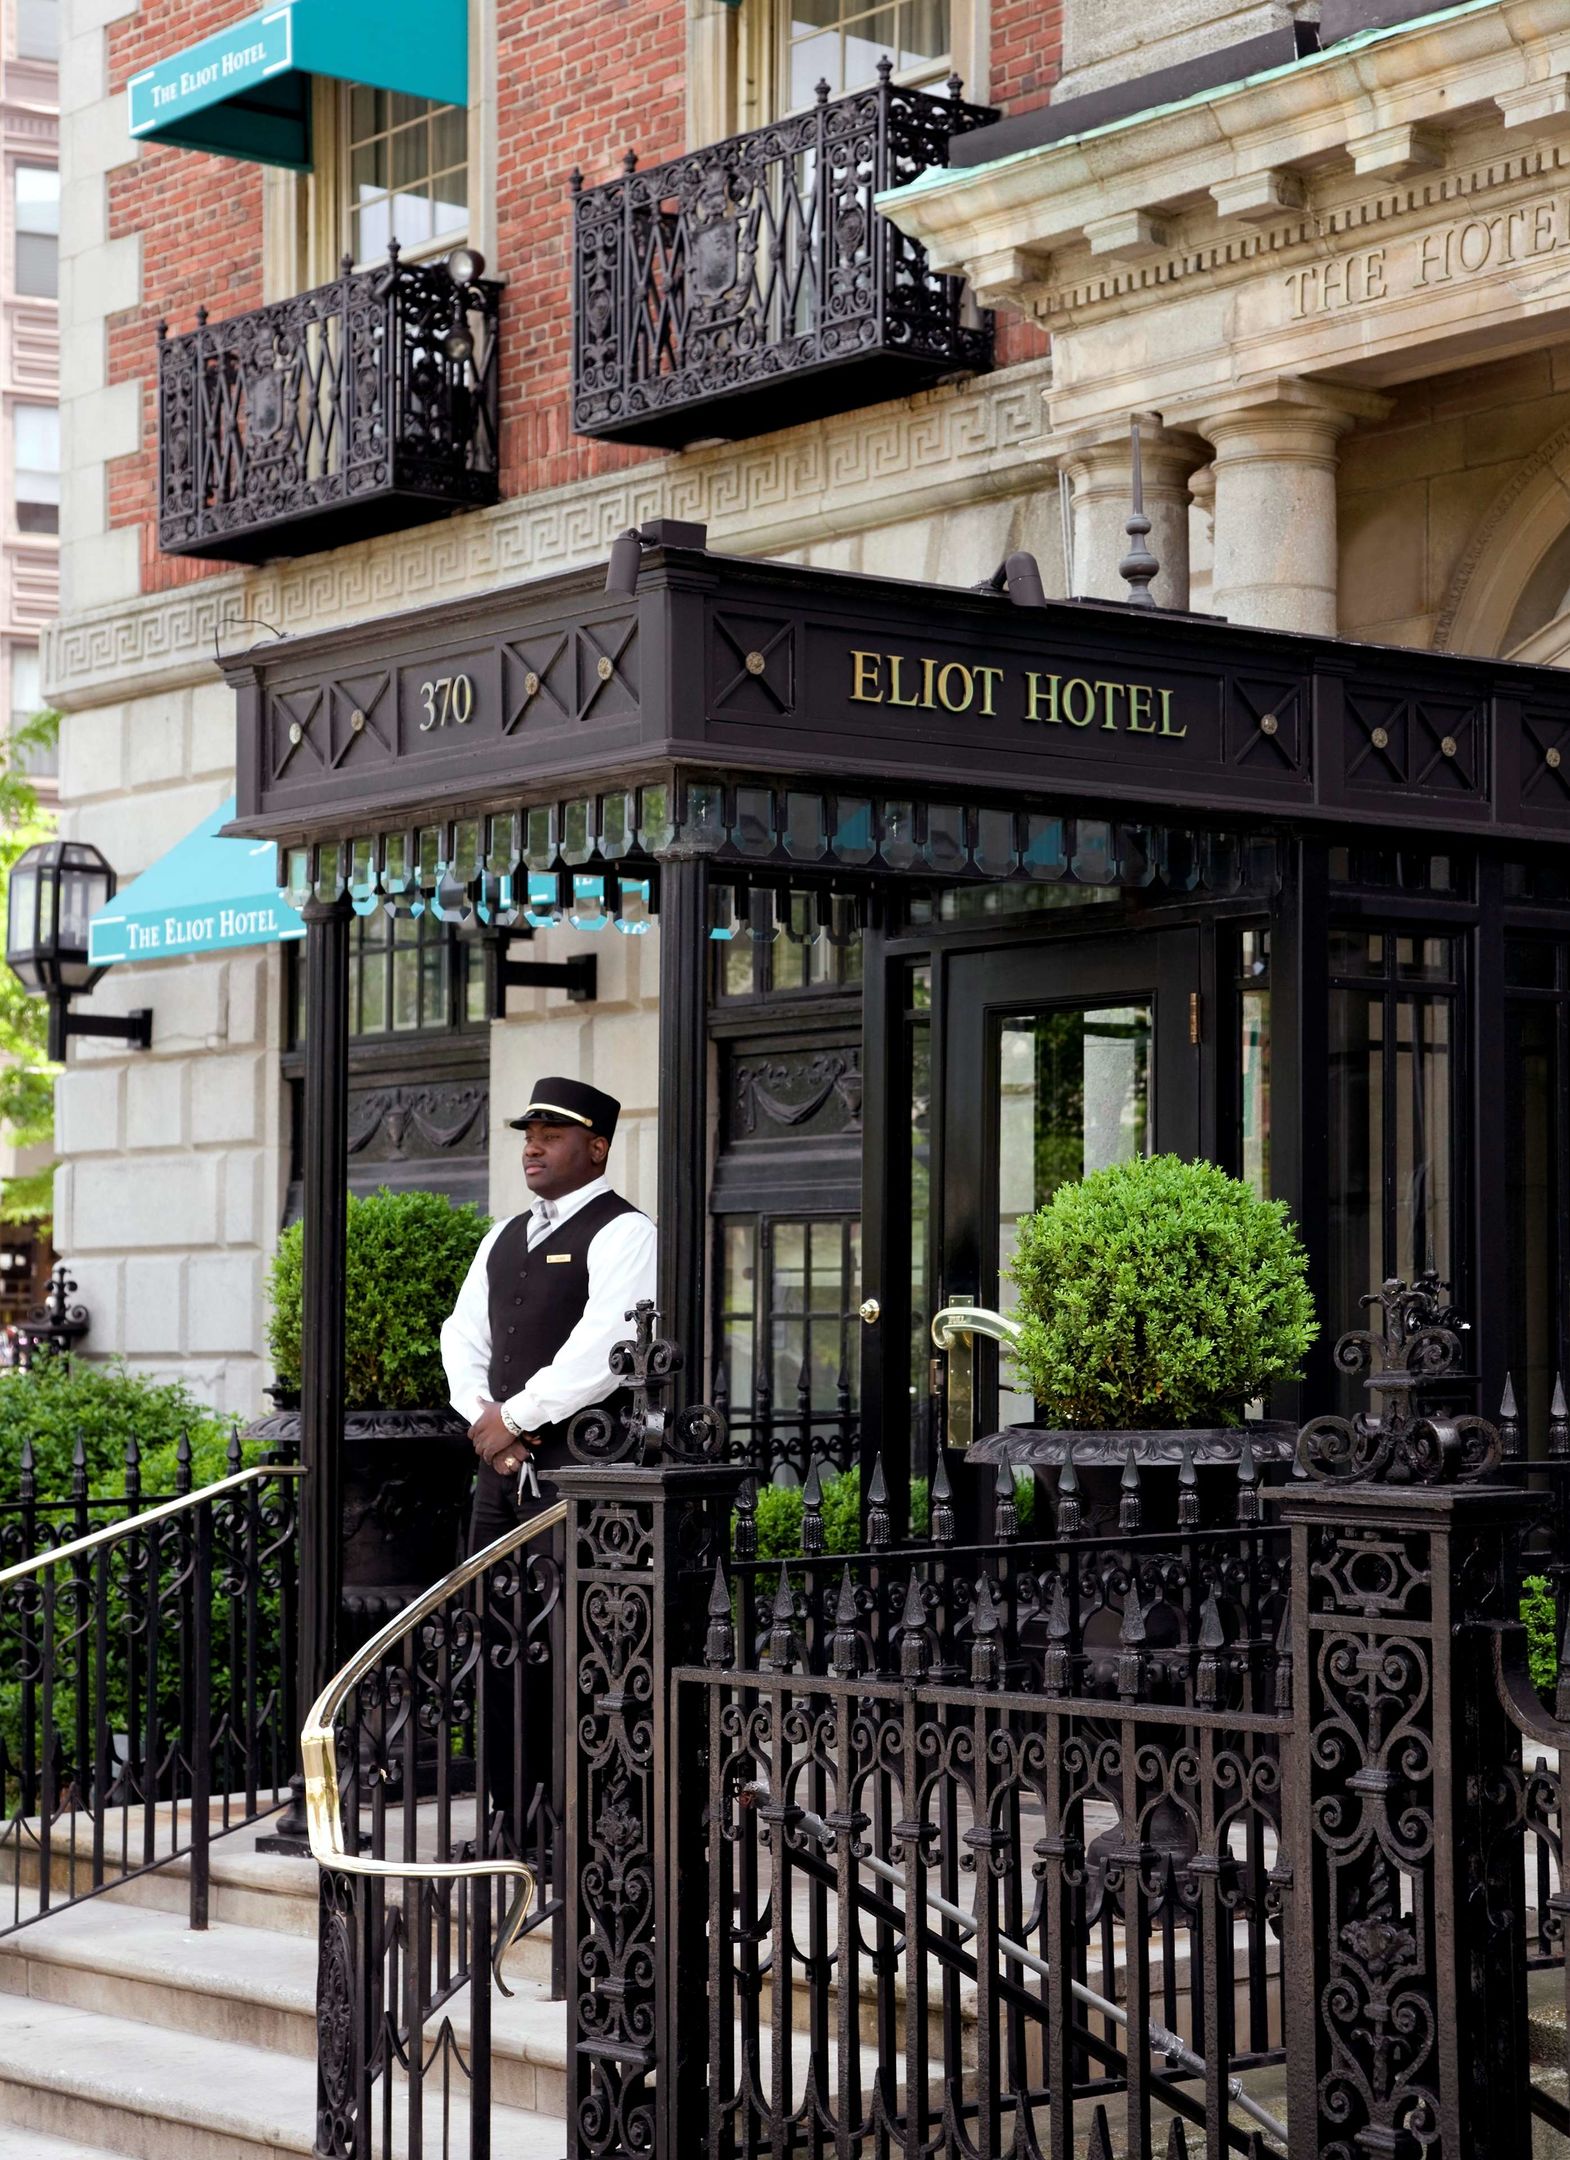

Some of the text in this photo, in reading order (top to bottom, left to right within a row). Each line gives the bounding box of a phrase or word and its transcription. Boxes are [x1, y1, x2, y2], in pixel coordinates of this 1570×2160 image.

[151, 42, 267, 108] THE ELIOT HOTEL
[1284, 249, 1388, 320] THE
[420, 674, 472, 731] 370
[849, 650, 1188, 738] ELIOT HOTEL
[126, 909, 278, 950] THE ELIOT HOTEL
